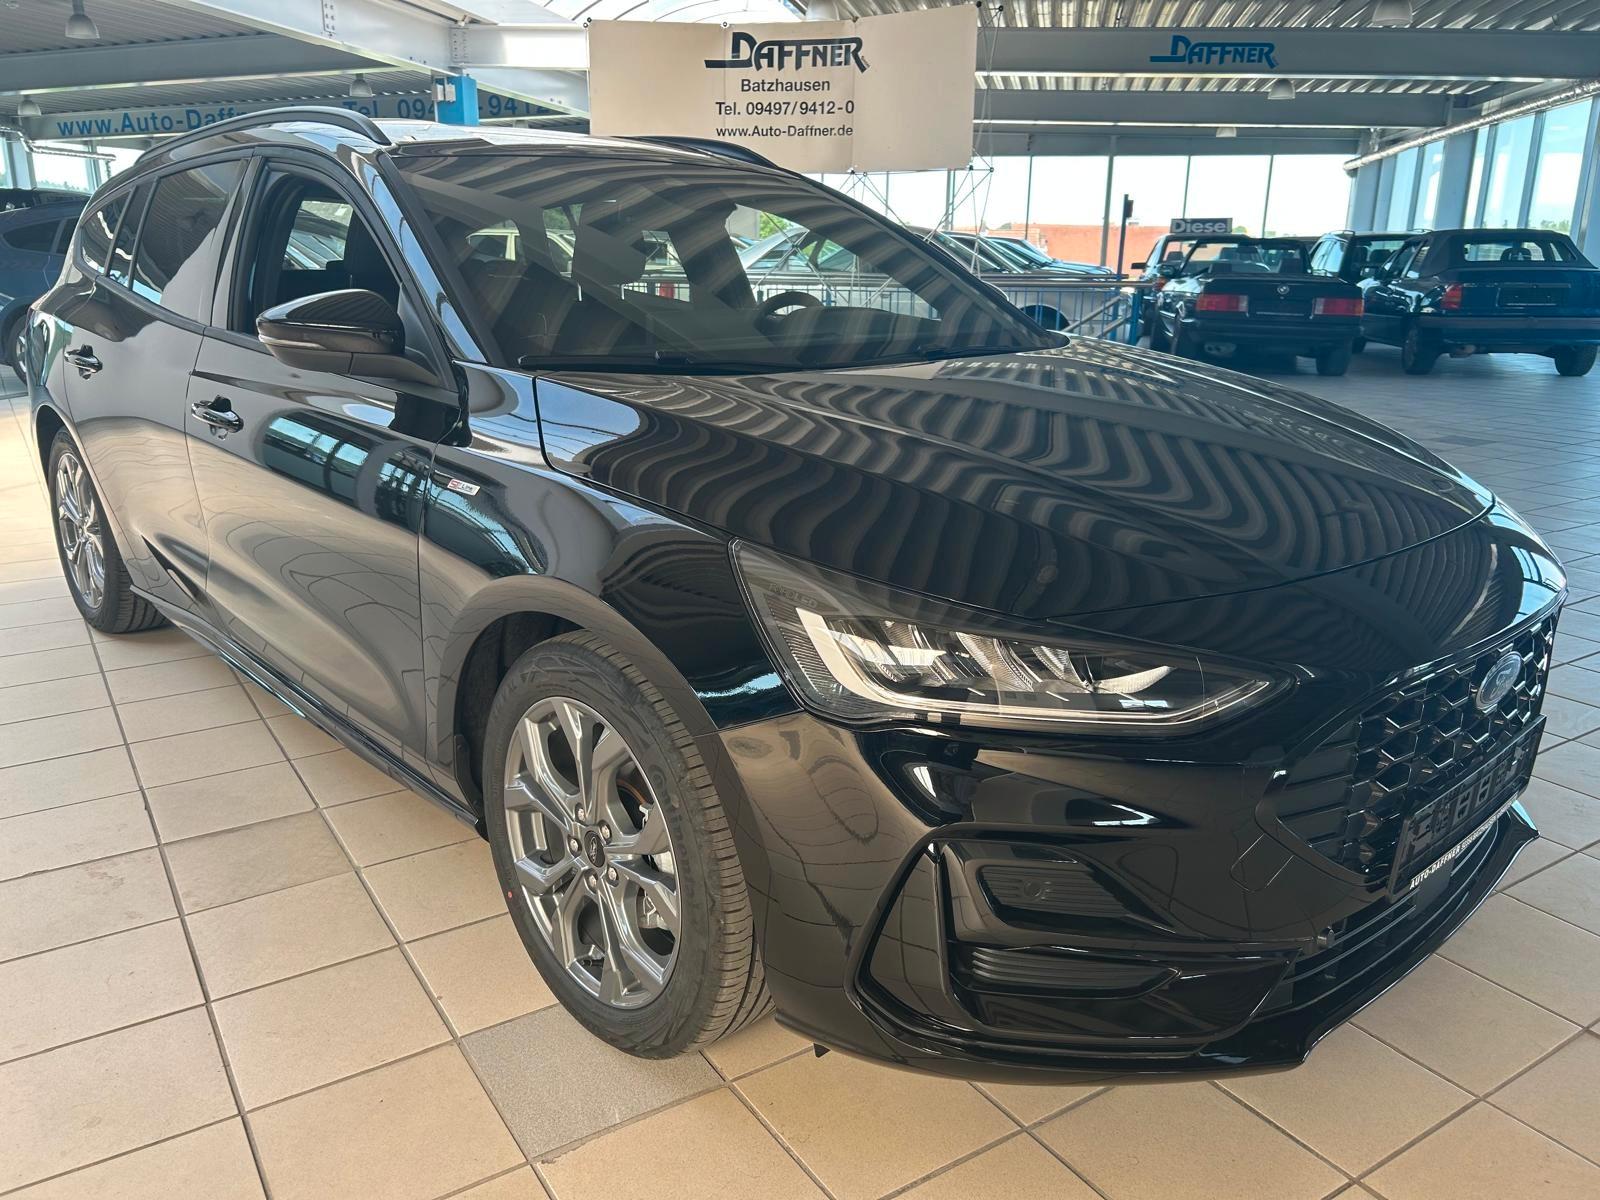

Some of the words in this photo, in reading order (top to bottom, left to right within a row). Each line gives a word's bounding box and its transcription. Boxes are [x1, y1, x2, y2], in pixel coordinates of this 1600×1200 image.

[704, 32, 867, 73] DAFFNER
[1150, 35, 1277, 69] DAFFNER
[741, 78, 831, 93] Batzhausen
[716, 102, 741, 116] Tel.
[746, 100, 855, 116] 09497/9412-0
[716, 124, 854, 137] www.Auto-Daffner.de
[1171, 220, 1232, 233] Diesel
[1409, 846, 1461, 890] AUTO-DAFFNER
